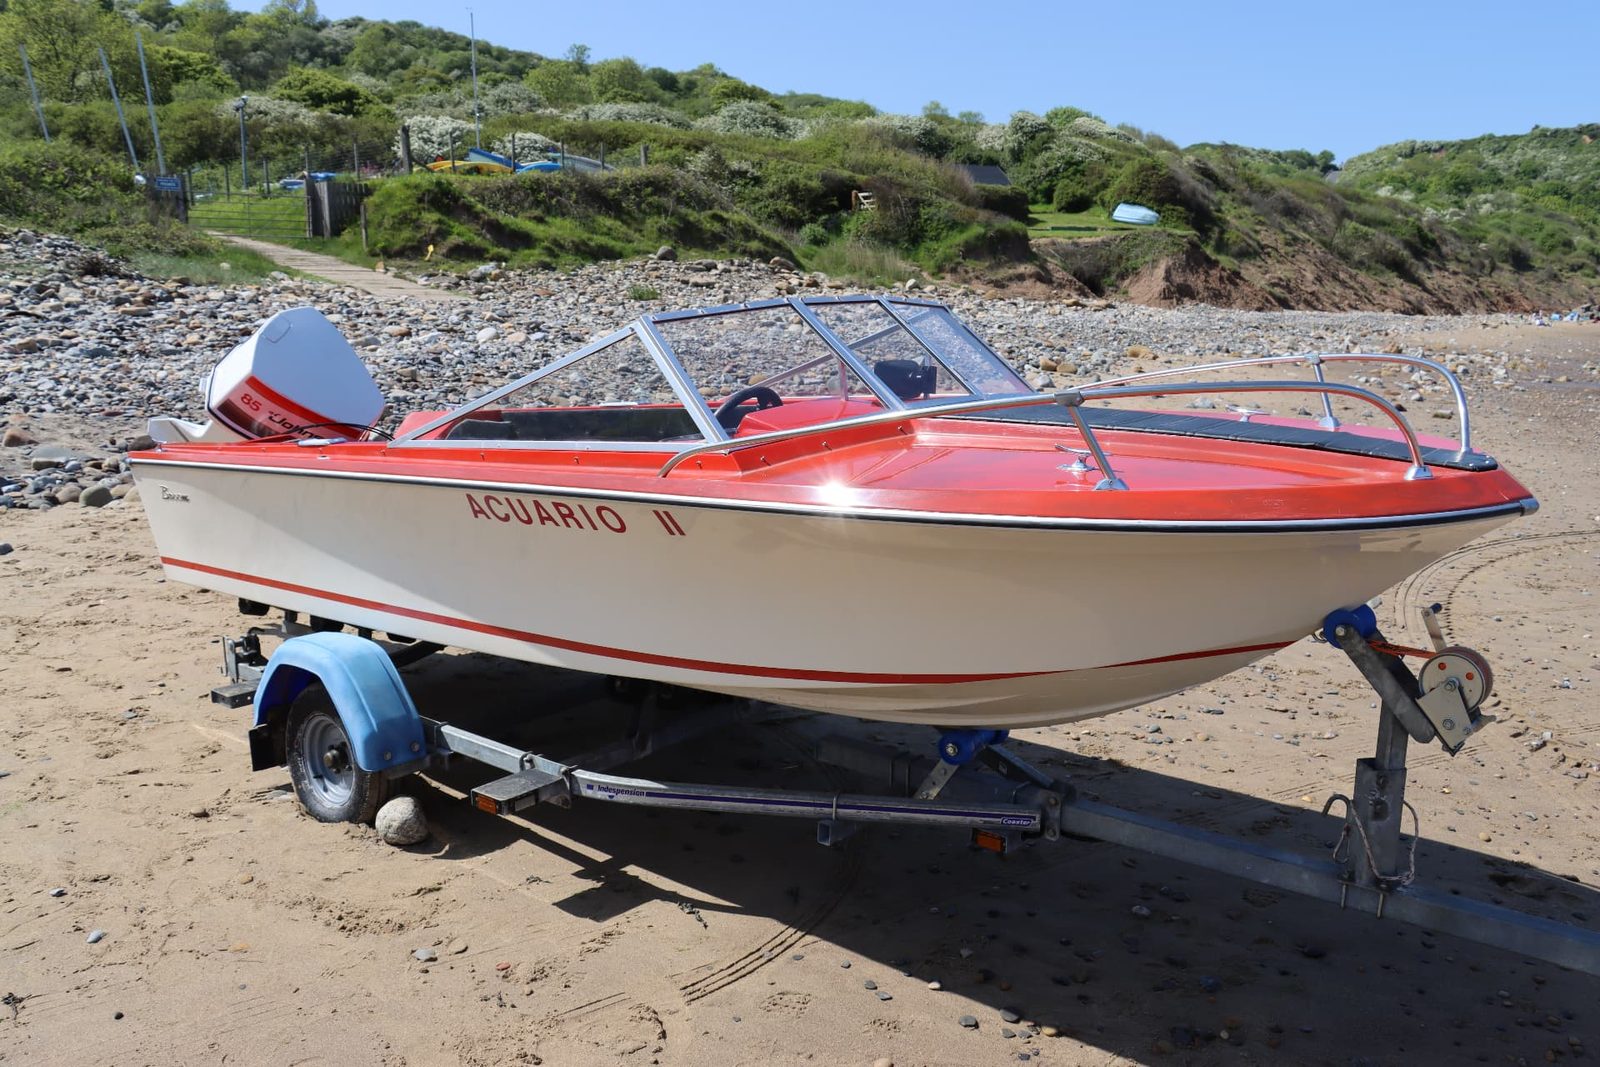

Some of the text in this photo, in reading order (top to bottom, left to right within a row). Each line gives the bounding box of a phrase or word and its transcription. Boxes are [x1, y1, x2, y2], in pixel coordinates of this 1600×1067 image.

[240, 393, 262, 412] 85
[465, 493, 686, 536] ACUARIO II
[597, 784, 645, 797] Indespension
[1002, 818, 1031, 826] Coaster
